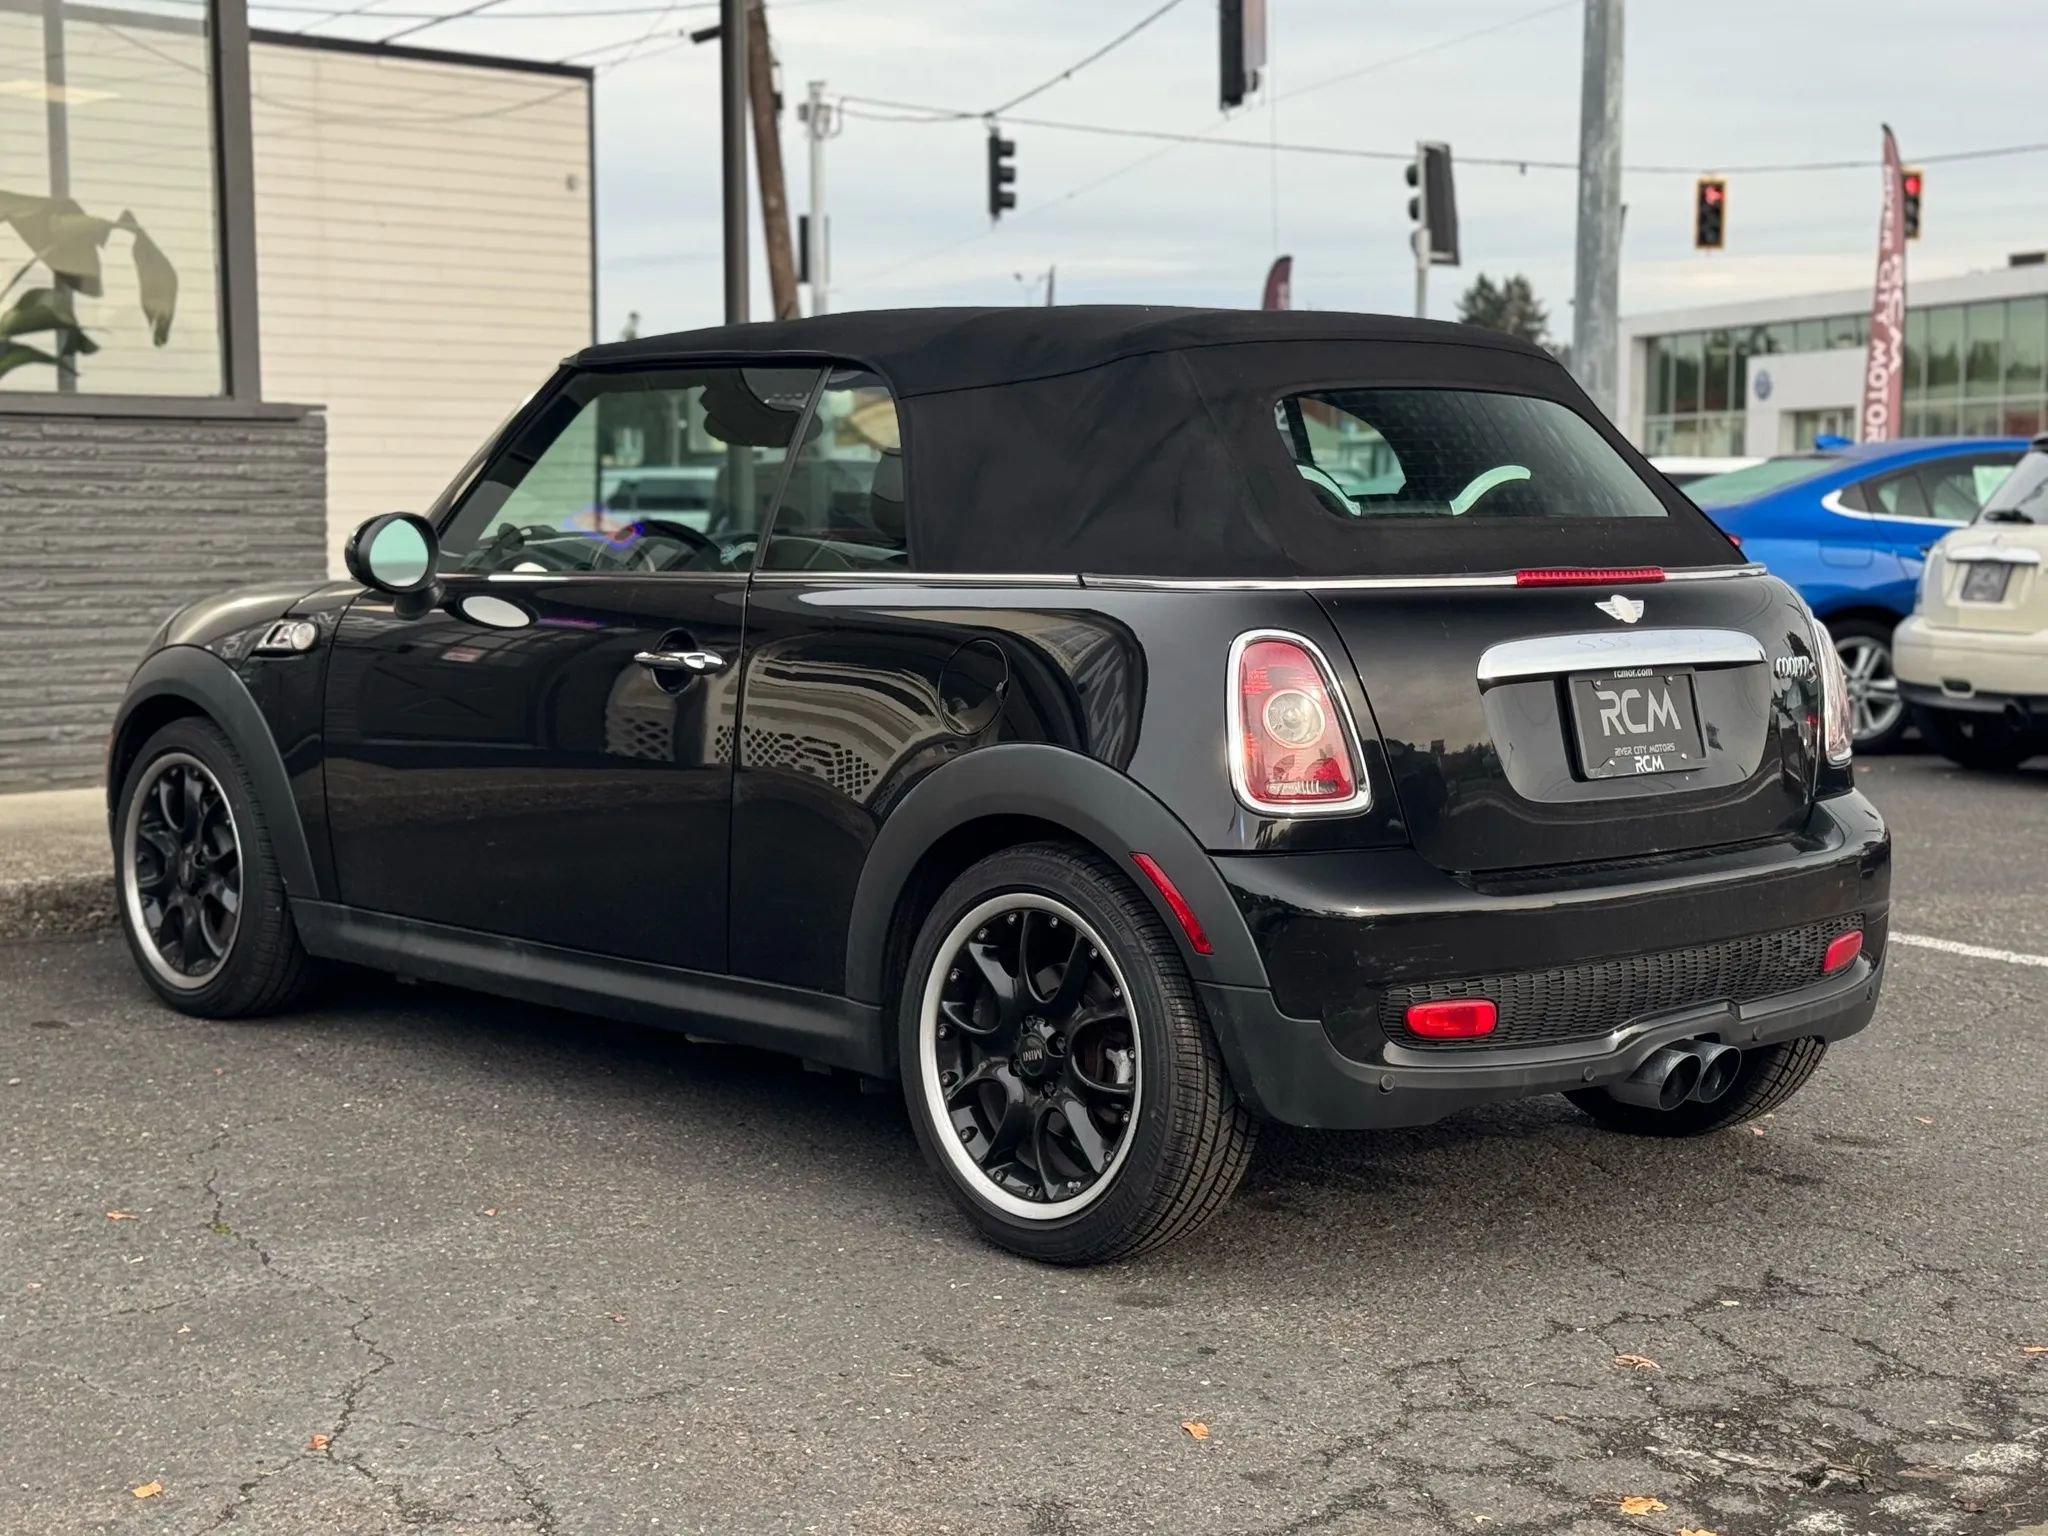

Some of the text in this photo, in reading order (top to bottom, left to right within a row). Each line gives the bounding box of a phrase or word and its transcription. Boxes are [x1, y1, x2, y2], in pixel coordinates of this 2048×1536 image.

[1876, 260, 1892, 327] CITY
[1807, 662, 1817, 684] S
[1595, 688, 1682, 736] RCM
[1614, 742, 1675, 757] RIVER CITY MOTORS
[1634, 755, 1665, 773] RCM
[1022, 1048, 1043, 1062] MINI
